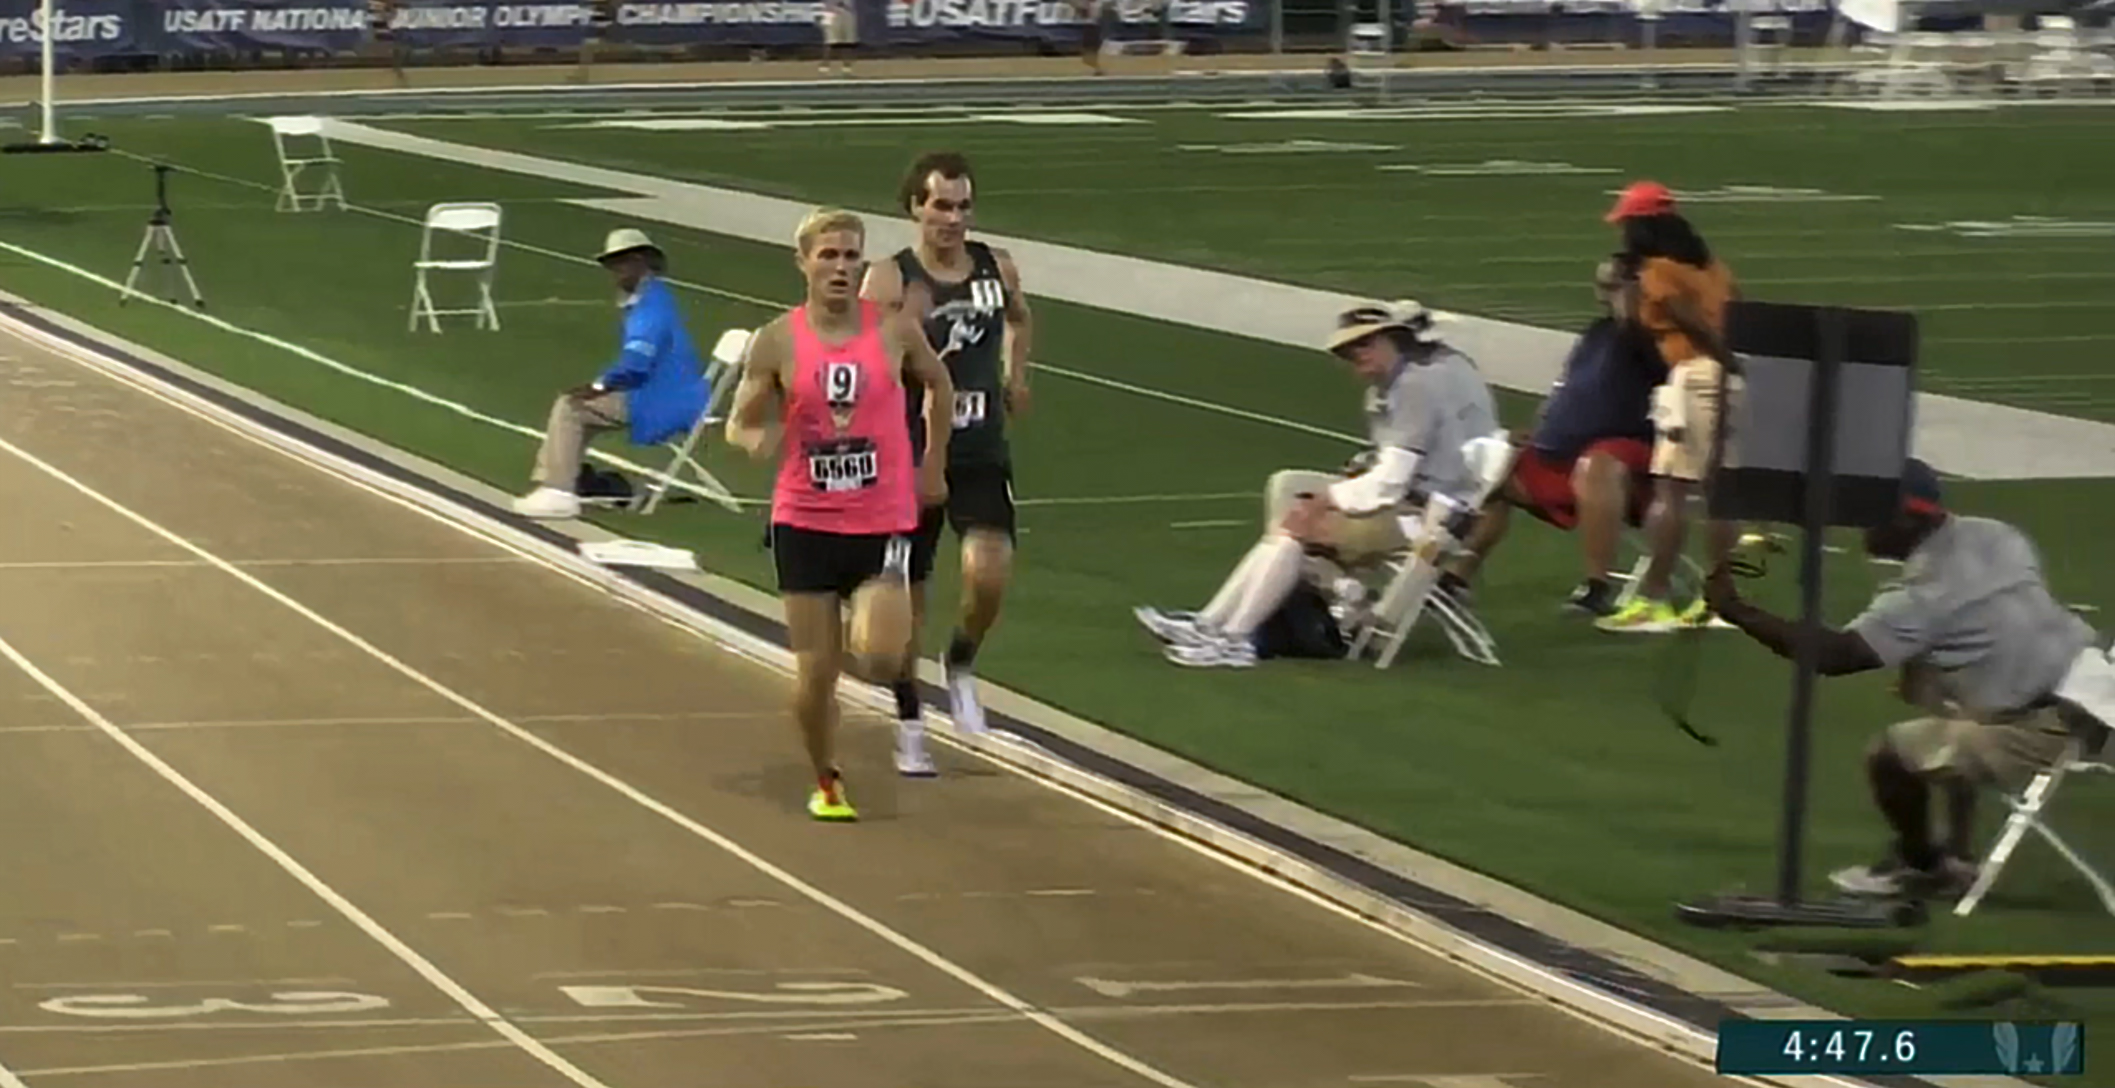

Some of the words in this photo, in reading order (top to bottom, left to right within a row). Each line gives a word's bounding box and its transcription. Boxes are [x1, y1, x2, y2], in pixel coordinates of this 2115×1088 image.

[164, 10, 246, 33] USATF
[251, 7, 373, 31] NATIONA
[834, 366, 852, 399] 9
[815, 454, 873, 481] 6560
